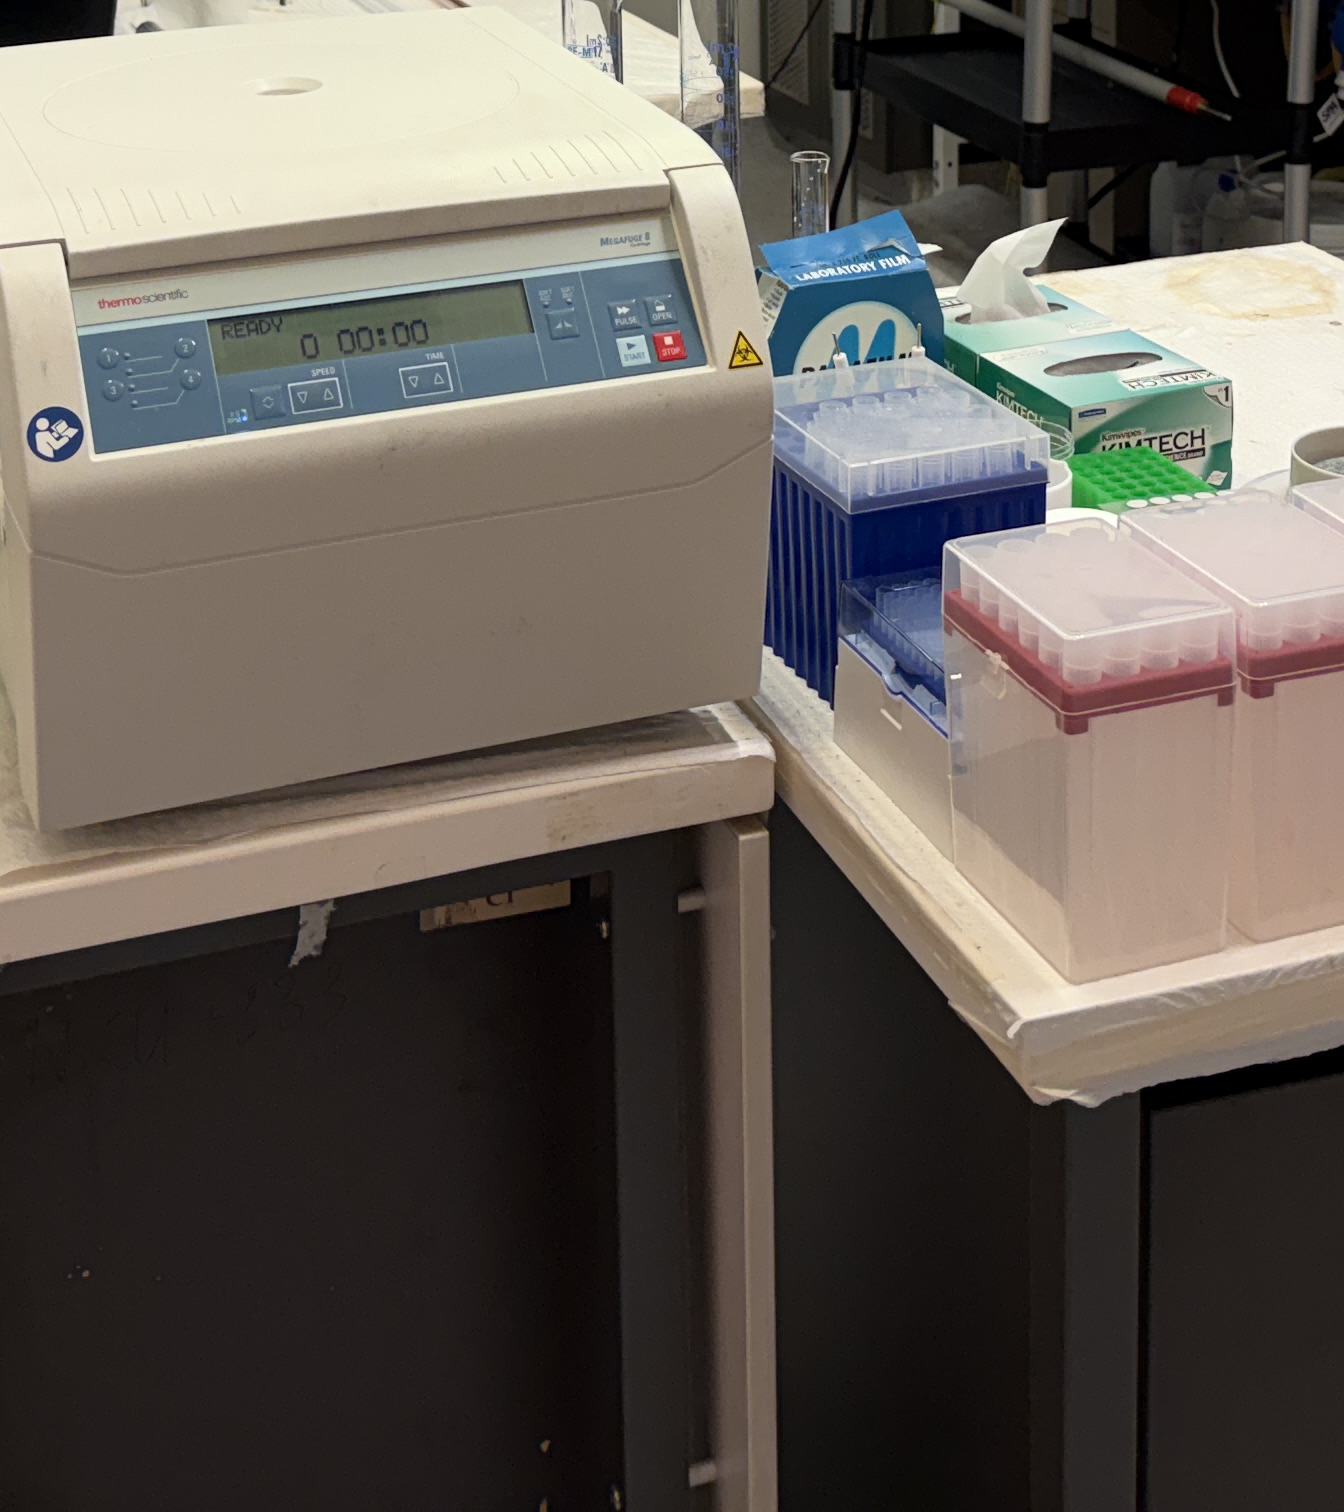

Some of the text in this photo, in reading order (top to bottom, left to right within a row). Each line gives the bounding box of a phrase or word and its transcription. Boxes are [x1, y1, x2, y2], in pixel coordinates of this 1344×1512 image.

[795, 254, 912, 282] LABORATORY FILM
[614, 316, 637, 326] PULSE
[652, 311, 673, 321] OPEN
[220, 317, 283, 340] READY
[301, 319, 429, 359] 0 00:00
[182, 343, 189, 353] 2
[661, 346, 681, 357] STOP
[425, 351, 445, 361] TIME
[623, 351, 646, 362] START
[311, 366, 336, 377] SPEED
[1129, 371, 1217, 389] KIMTECH
[110, 386, 117, 396] 3
[1224, 385, 1229, 402] 1
[995, 390, 1044, 428] KIMTECH
[1101, 429, 1143, 442] Kimwipes
